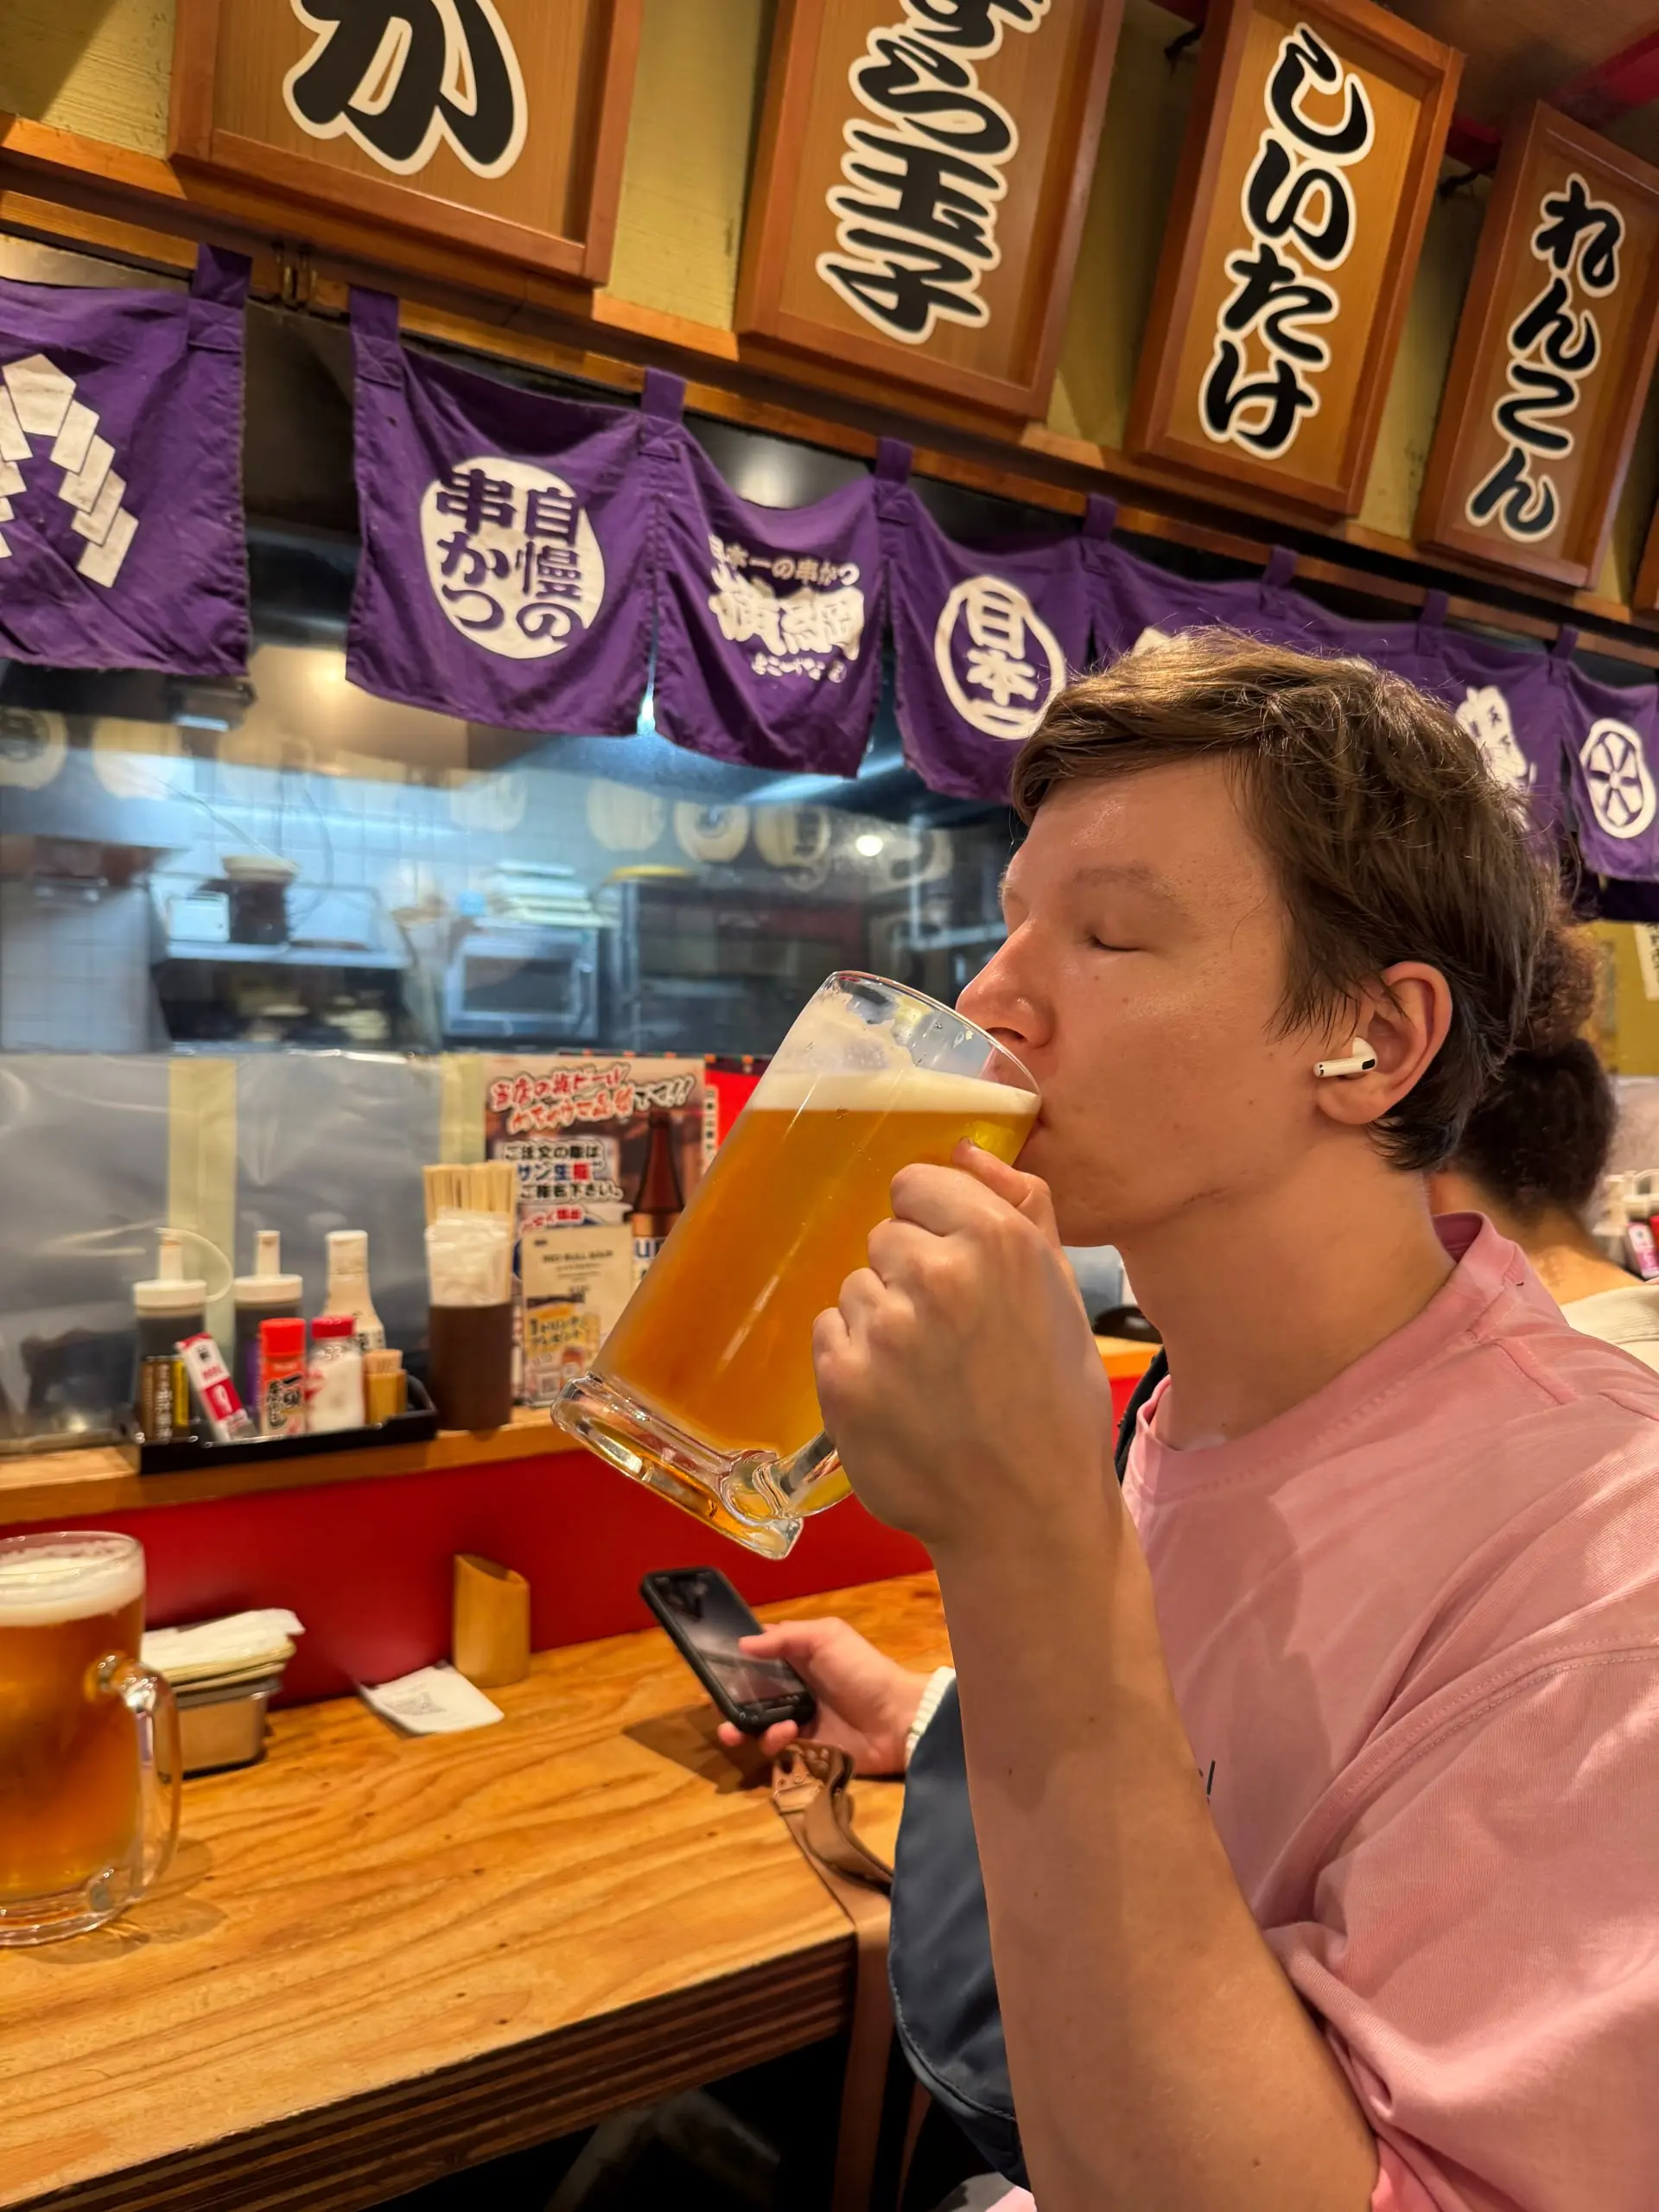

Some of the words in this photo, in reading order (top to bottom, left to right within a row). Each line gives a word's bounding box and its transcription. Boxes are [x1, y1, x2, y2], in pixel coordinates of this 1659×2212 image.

[1199, 23, 1374, 457] しいたけ
[1467, 175, 1624, 540] れんこん
[435, 467, 518, 632] 串かつ
[516, 486, 589, 641] 自慢の
